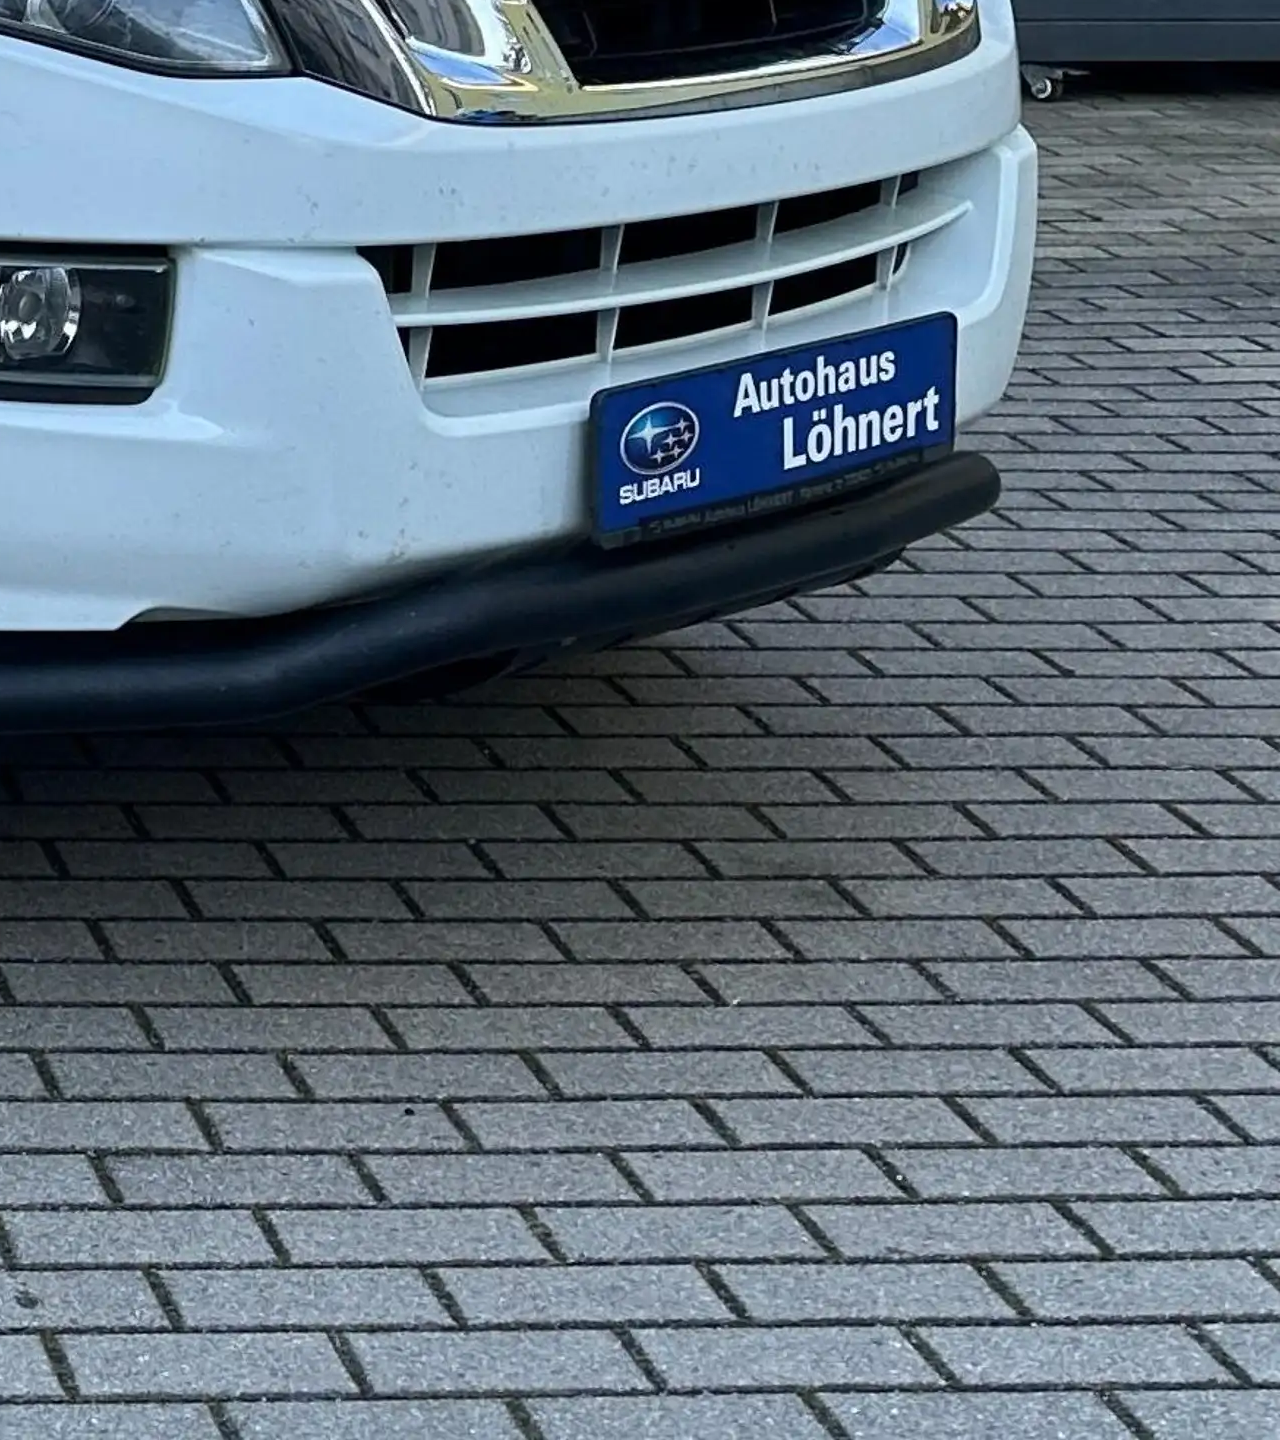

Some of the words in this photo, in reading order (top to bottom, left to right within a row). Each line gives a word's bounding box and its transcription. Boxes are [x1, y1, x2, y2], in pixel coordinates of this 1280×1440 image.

[733, 349, 896, 418] Autohaus
[782, 386, 940, 471] Löhnert
[619, 467, 700, 506] SUBARU
